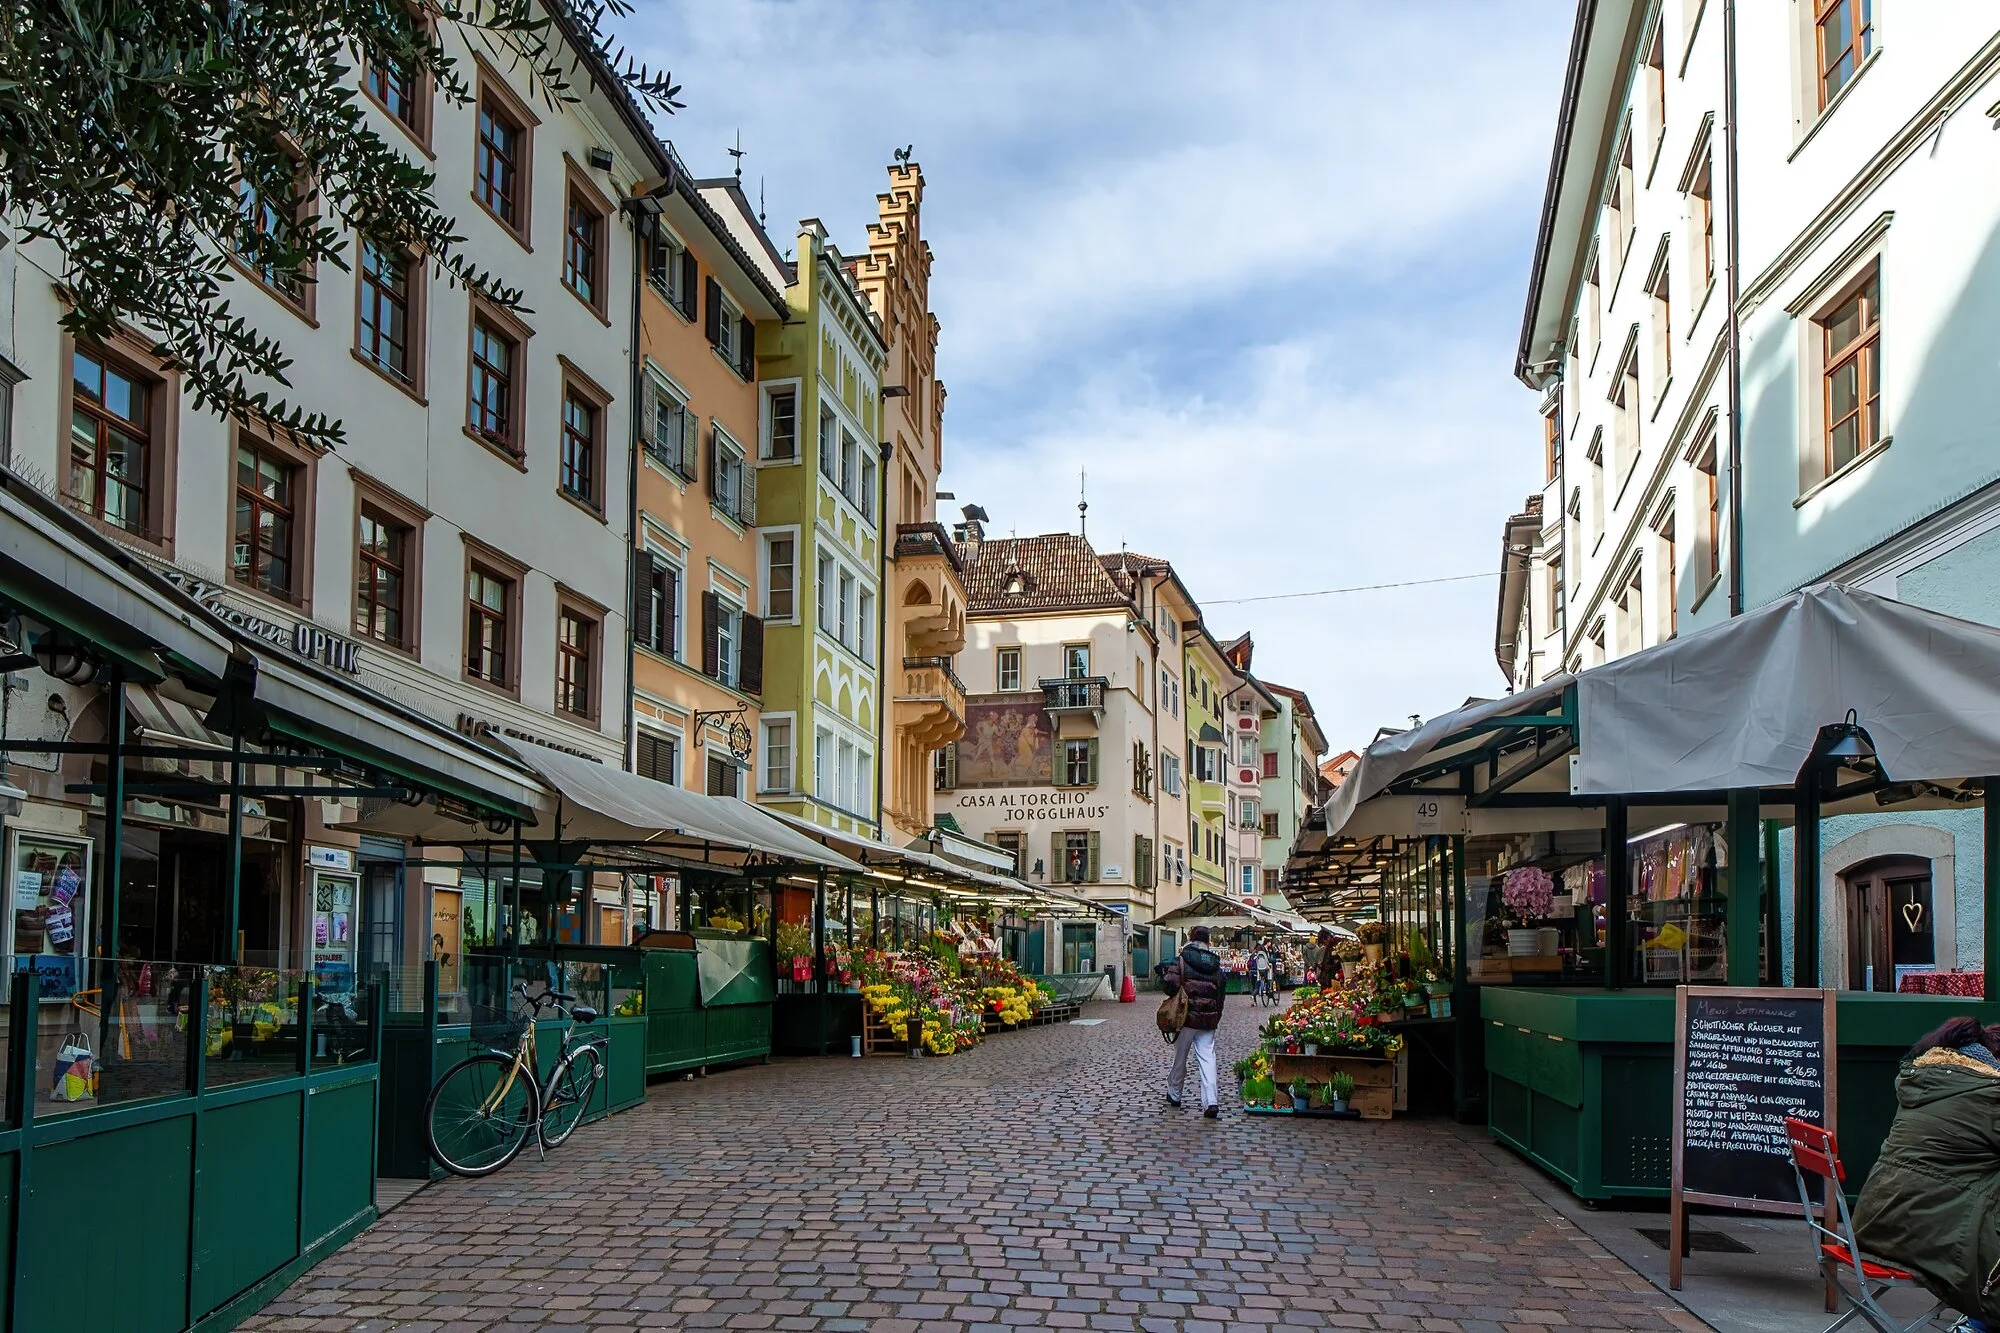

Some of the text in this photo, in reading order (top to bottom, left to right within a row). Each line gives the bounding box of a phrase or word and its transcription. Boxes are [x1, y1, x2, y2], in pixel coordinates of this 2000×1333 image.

[295, 623, 362, 674] OPTIK
[1417, 802, 1438, 818] 49
[1747, 1021, 1785, 1034] RÄUCHER
[1743, 1036, 1758, 1046] UND
[1783, 1065, 1818, 1078] €16,50
[1786, 1106, 1821, 1119] €10,00
[1714, 1141, 1721, 1149] E
